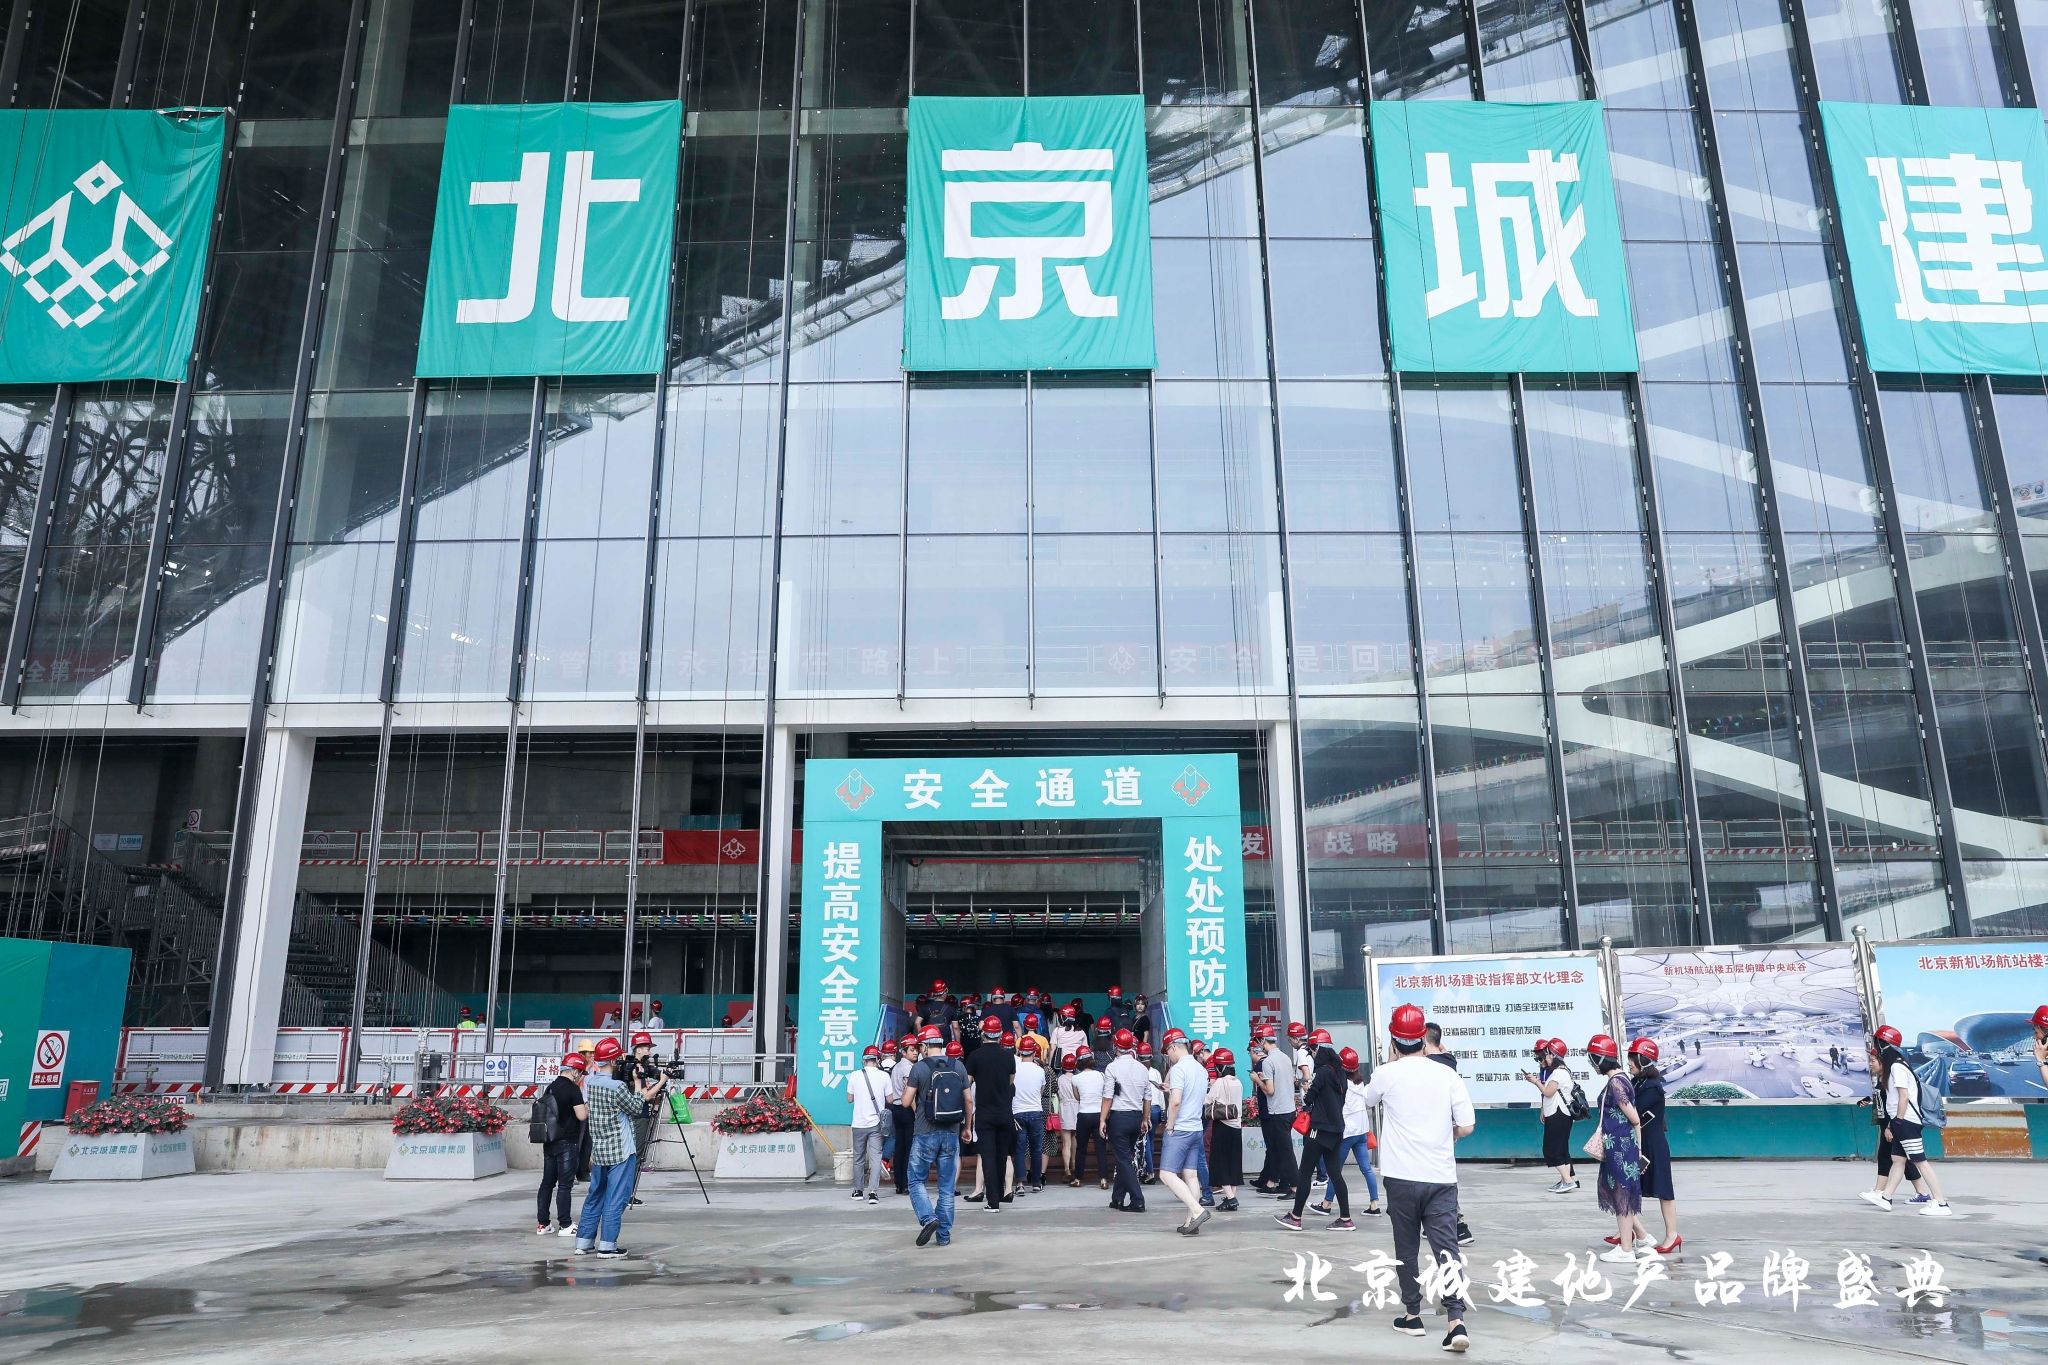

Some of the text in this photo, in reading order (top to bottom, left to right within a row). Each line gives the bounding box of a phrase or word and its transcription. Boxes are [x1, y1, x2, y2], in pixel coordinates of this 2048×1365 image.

[457, 151, 641, 324] 北
[940, 141, 1119, 320] 京
[1413, 148, 1600, 320] 城
[1865, 152, 2048, 324] 建
[902, 765, 1144, 811] 安全通道
[1183, 835, 1231, 1049] 处处预防事
[817, 841, 862, 1089] 提高安全意识
[1394, 970, 1585, 989] 北京新机场建设指挥部文化理念
[1441, 1027, 1485, 1037] 设精品国门
[33, 1074, 60, 1084] 禁止吸烟
[536, 1064, 560, 1076] 合格
[80, 1144, 138, 1156] 北京城建集团
[409, 1144, 466, 1155] 北京城建集团
[739, 1144, 796, 1154] 北京城建集团
